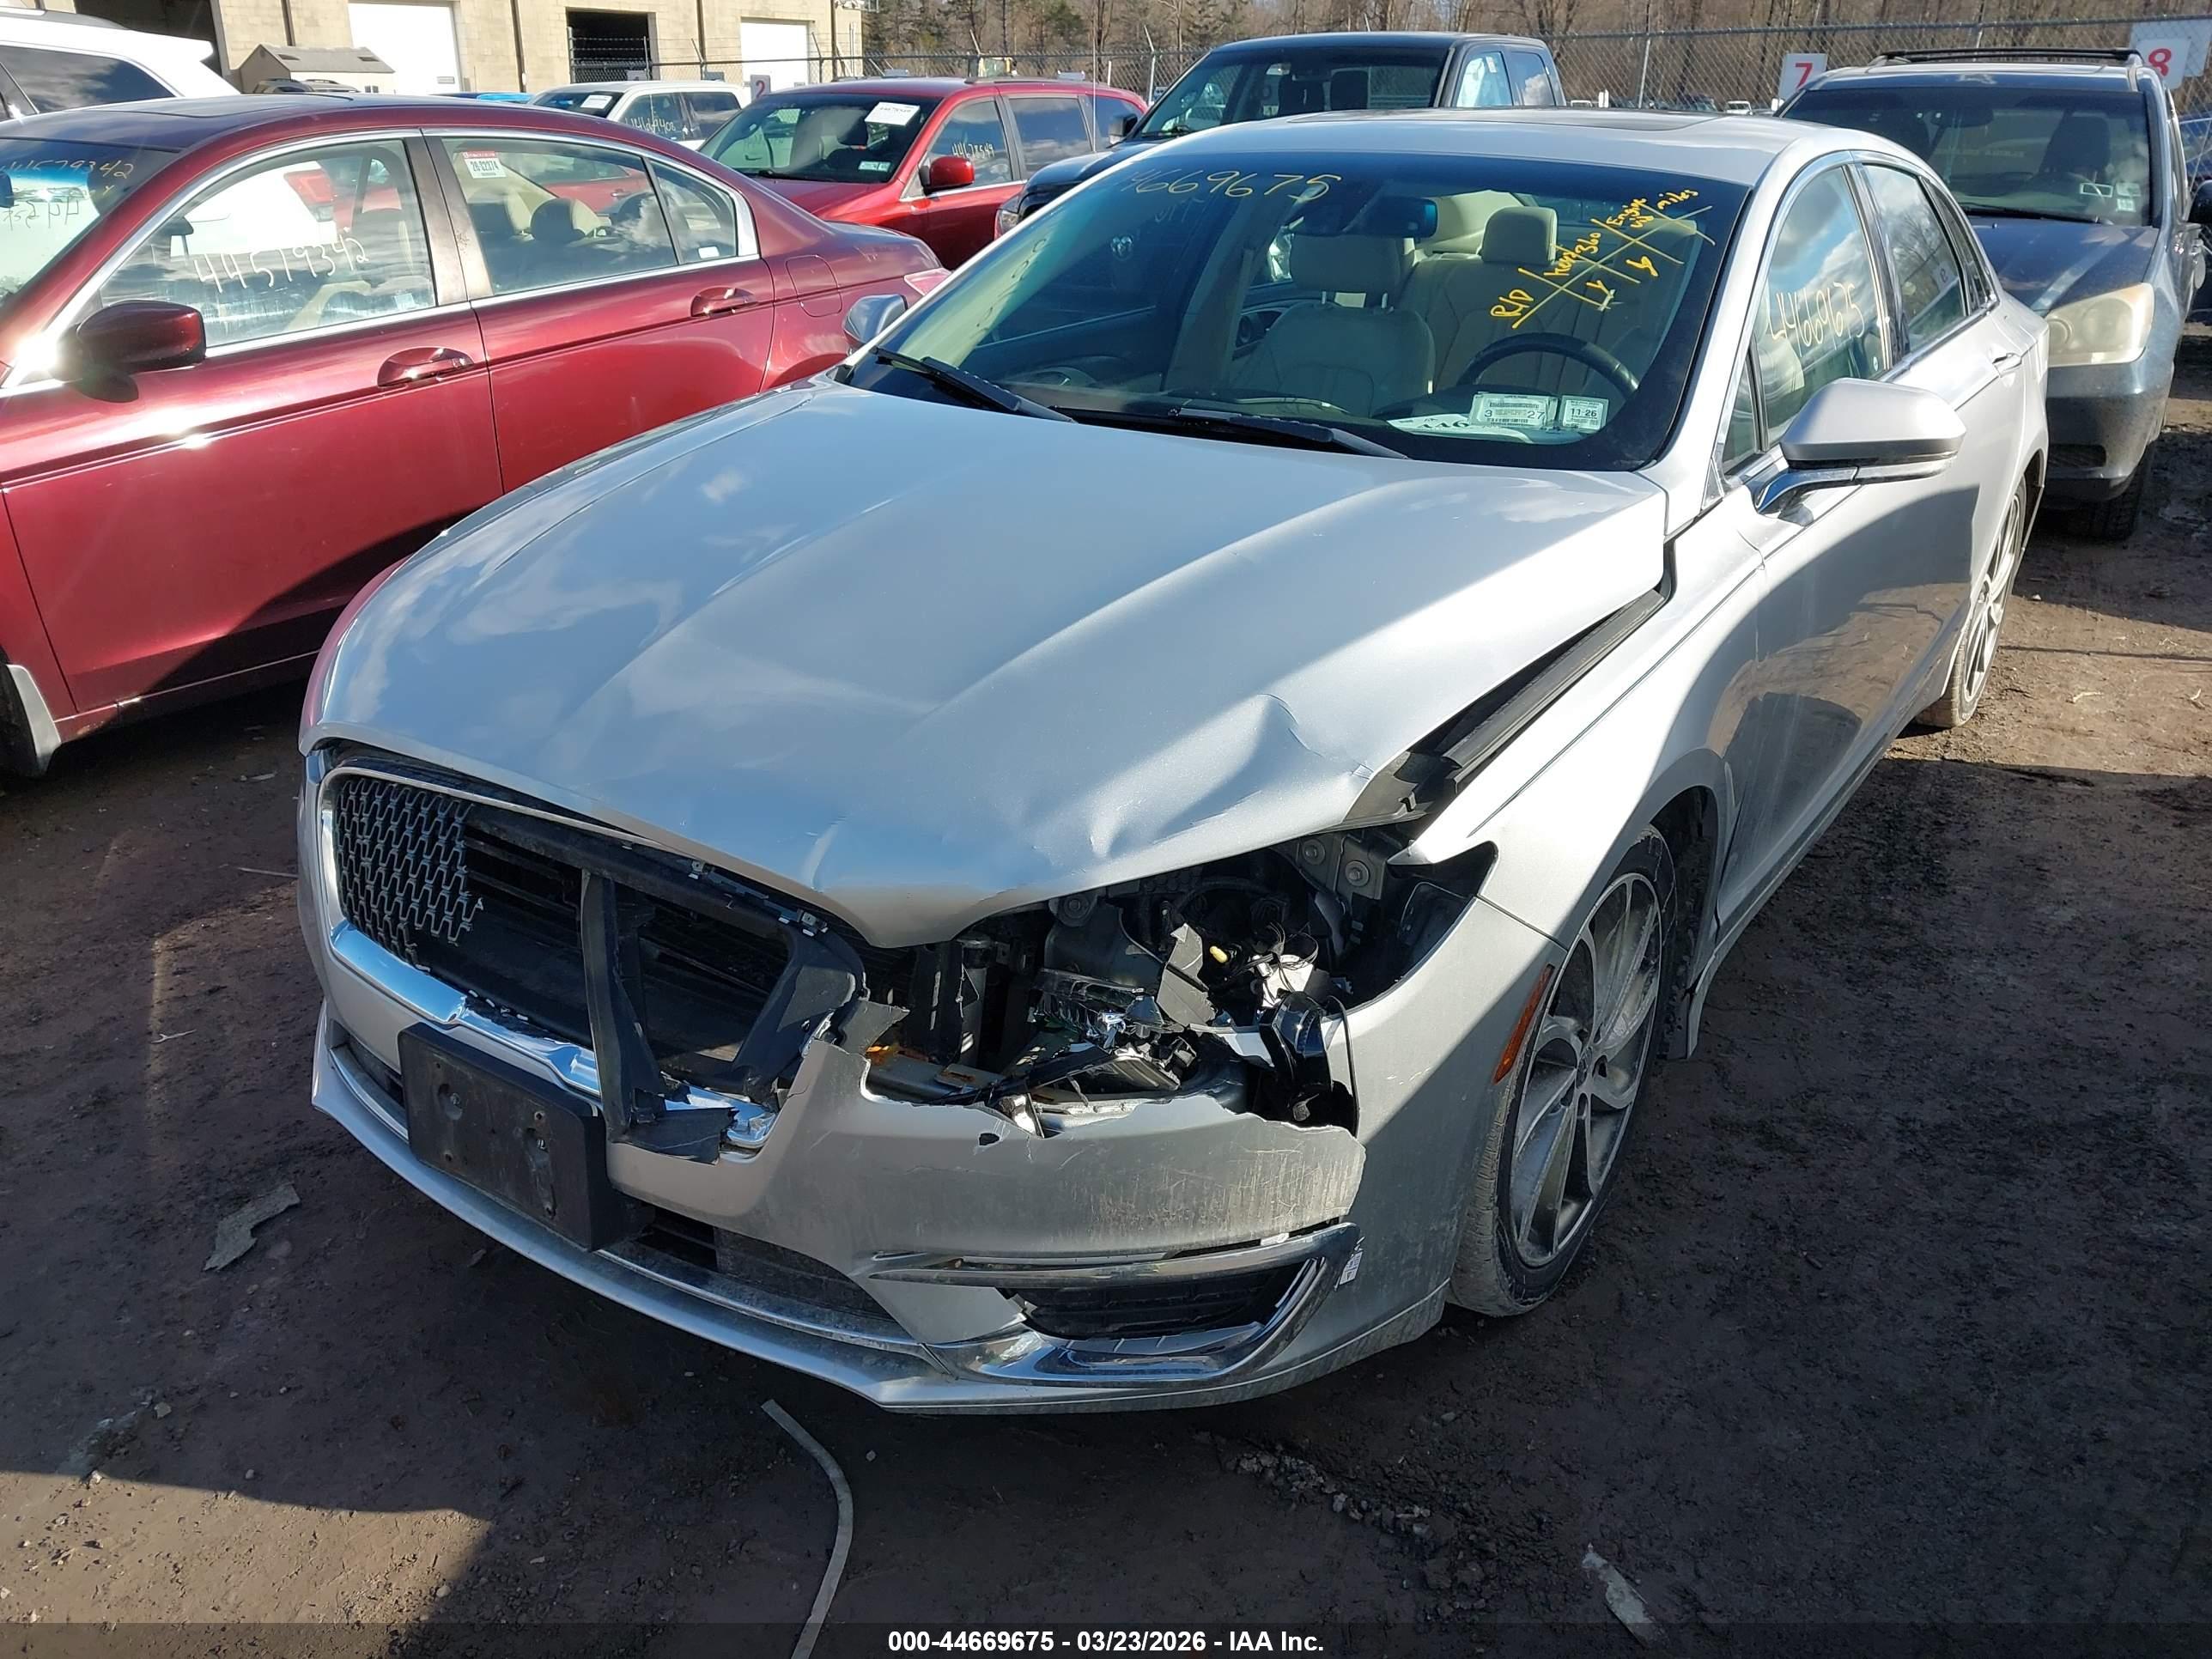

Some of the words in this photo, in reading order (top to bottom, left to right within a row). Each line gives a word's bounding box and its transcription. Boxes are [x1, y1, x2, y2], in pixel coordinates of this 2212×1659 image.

[1795, 62, 1813, 89] 7
[2148, 48, 2172, 76] 8
[755, 80, 766, 100] 2
[194, 234, 369, 293] 44579342
[1527, 410, 1546, 419] 27
